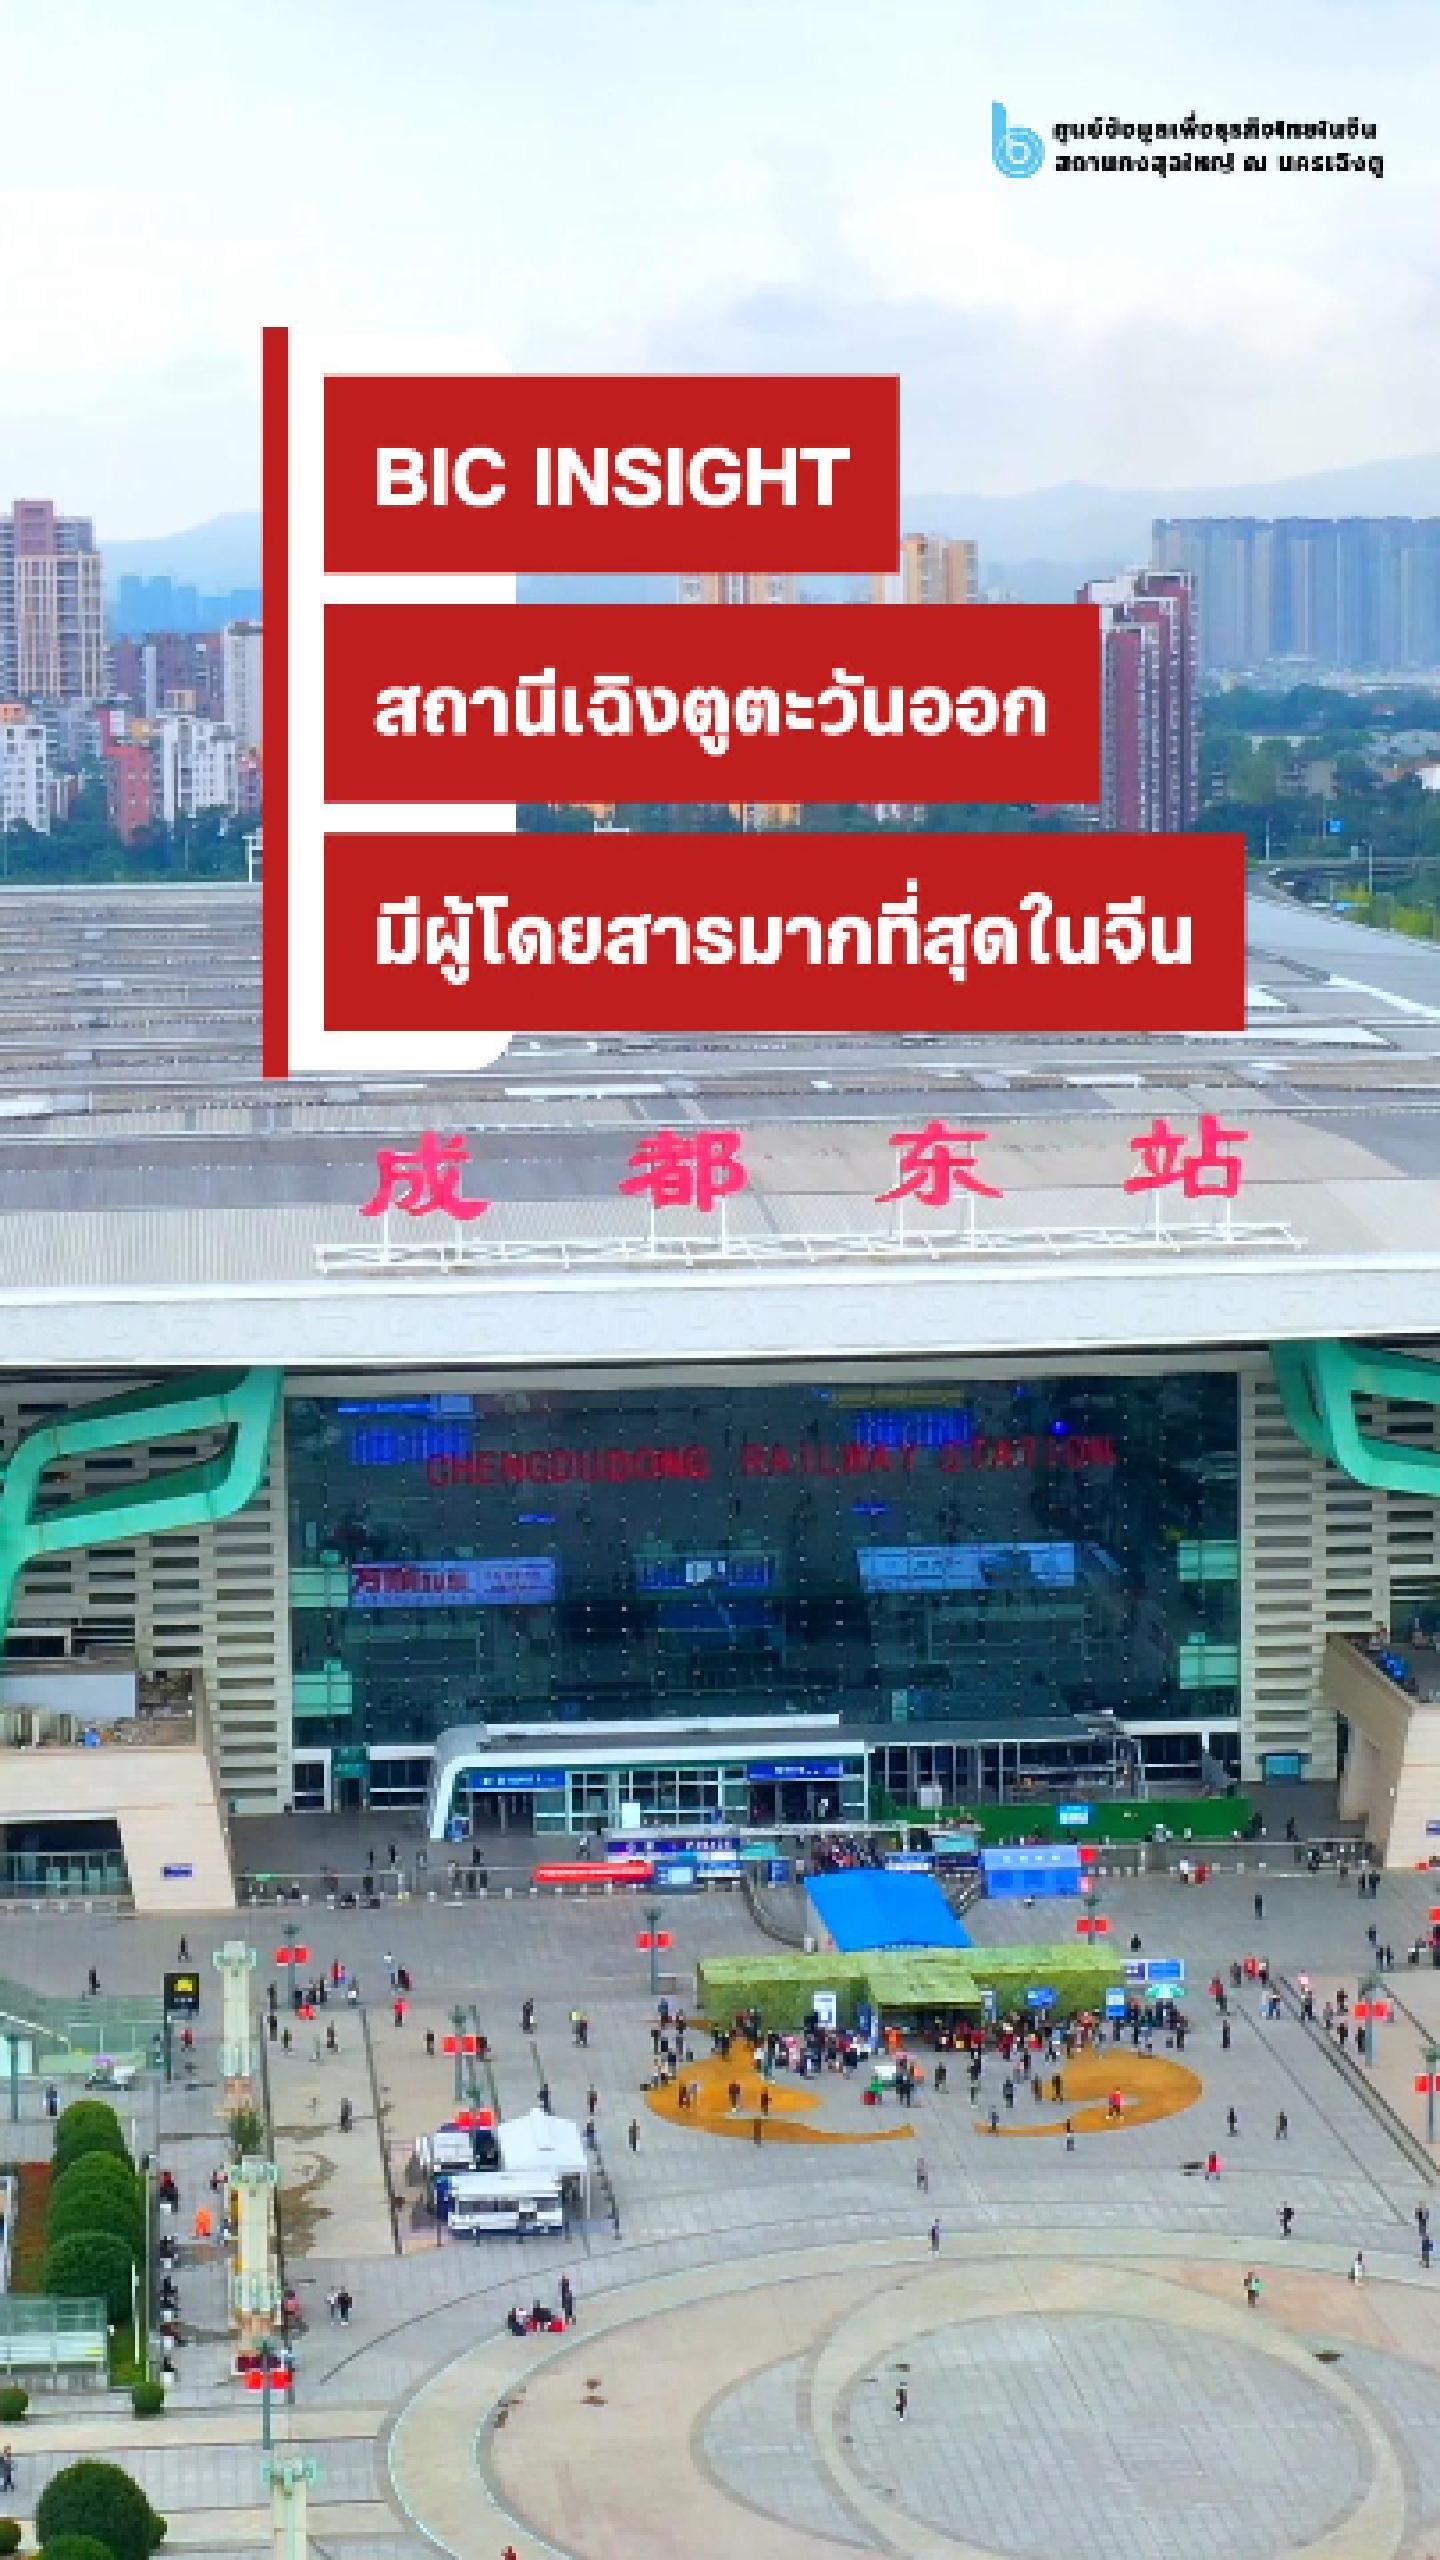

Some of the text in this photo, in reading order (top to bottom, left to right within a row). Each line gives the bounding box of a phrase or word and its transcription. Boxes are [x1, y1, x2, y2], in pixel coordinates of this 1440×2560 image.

[362, 1114, 1250, 1221] 成都东站
[426, 1444, 711, 1487] CHENGDUDONG
[740, 1443, 916, 1477] RAILWAY
